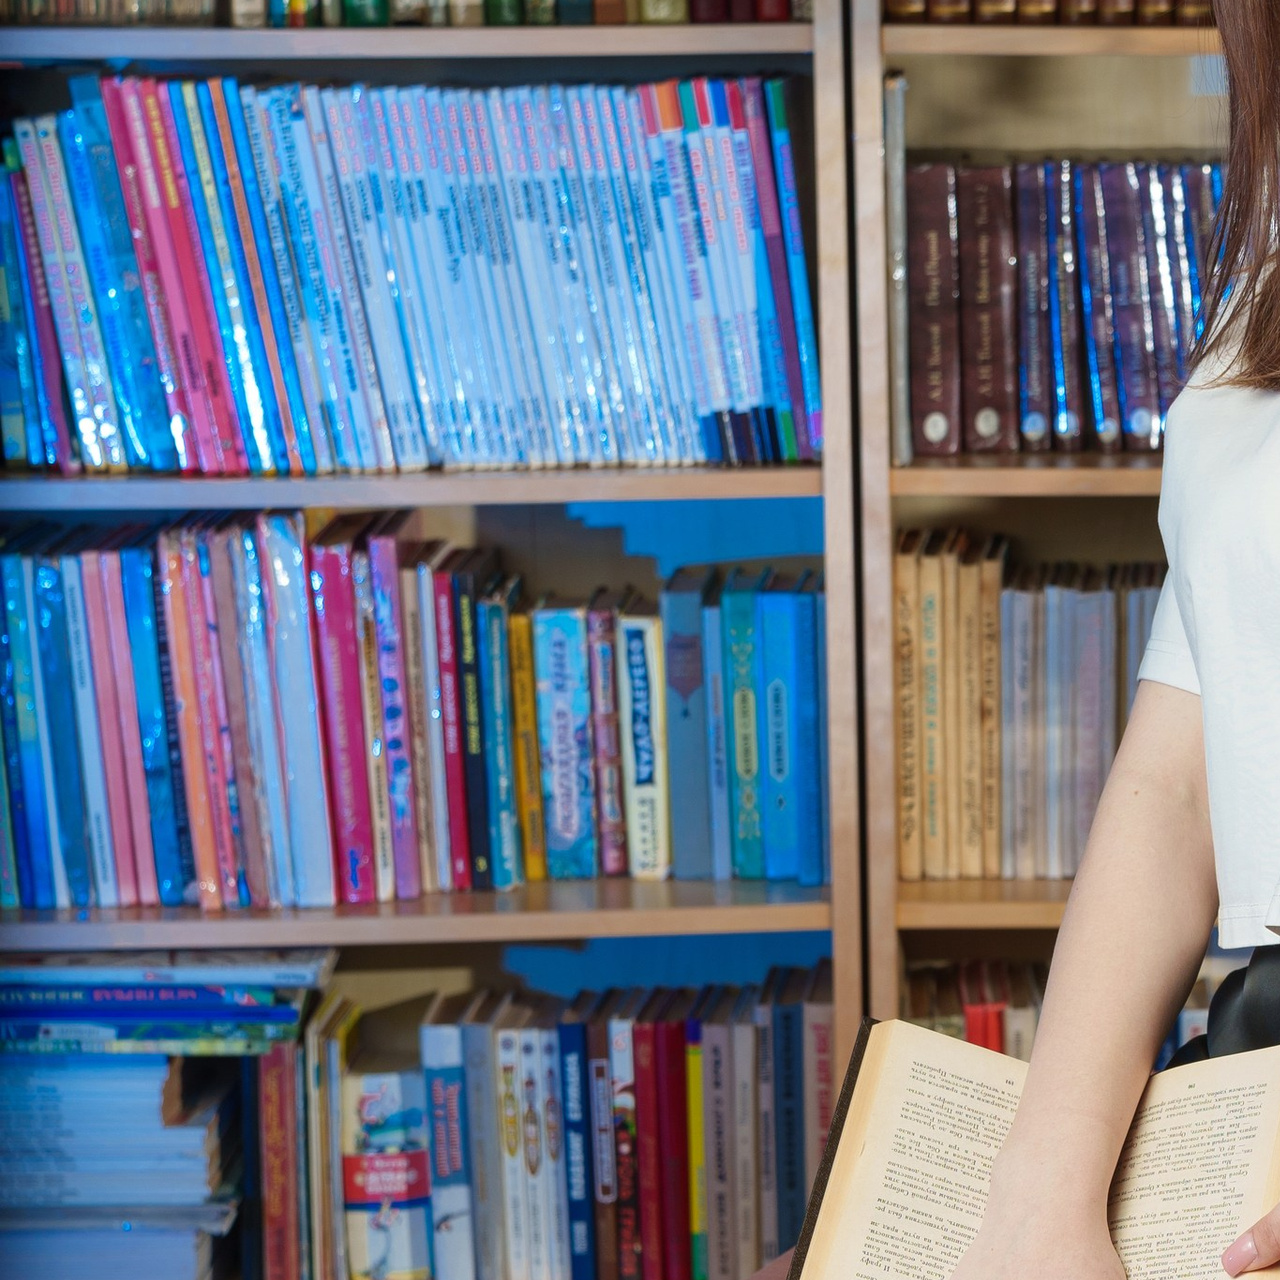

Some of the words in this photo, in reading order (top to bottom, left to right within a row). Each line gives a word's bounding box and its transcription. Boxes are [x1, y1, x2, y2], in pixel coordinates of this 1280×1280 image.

[927, 322, 941, 367] Толстой
[978, 313, 992, 361] Толстой
[631, 635, 656, 780] ЧУДО-ДЕРЕВО
[566, 1052, 581, 1122] ЕРМАКА
[570, 1131, 585, 1201] ПОДВИГ
[876, 1197, 909, 1211] областям
[910, 1191, 941, 1205] северной
[904, 1214, 948, 1232] путешествия
[861, 1249, 891, 1262] избегать
[884, 1248, 915, 1262] особенно
[894, 1259, 923, 1272] удобнее
